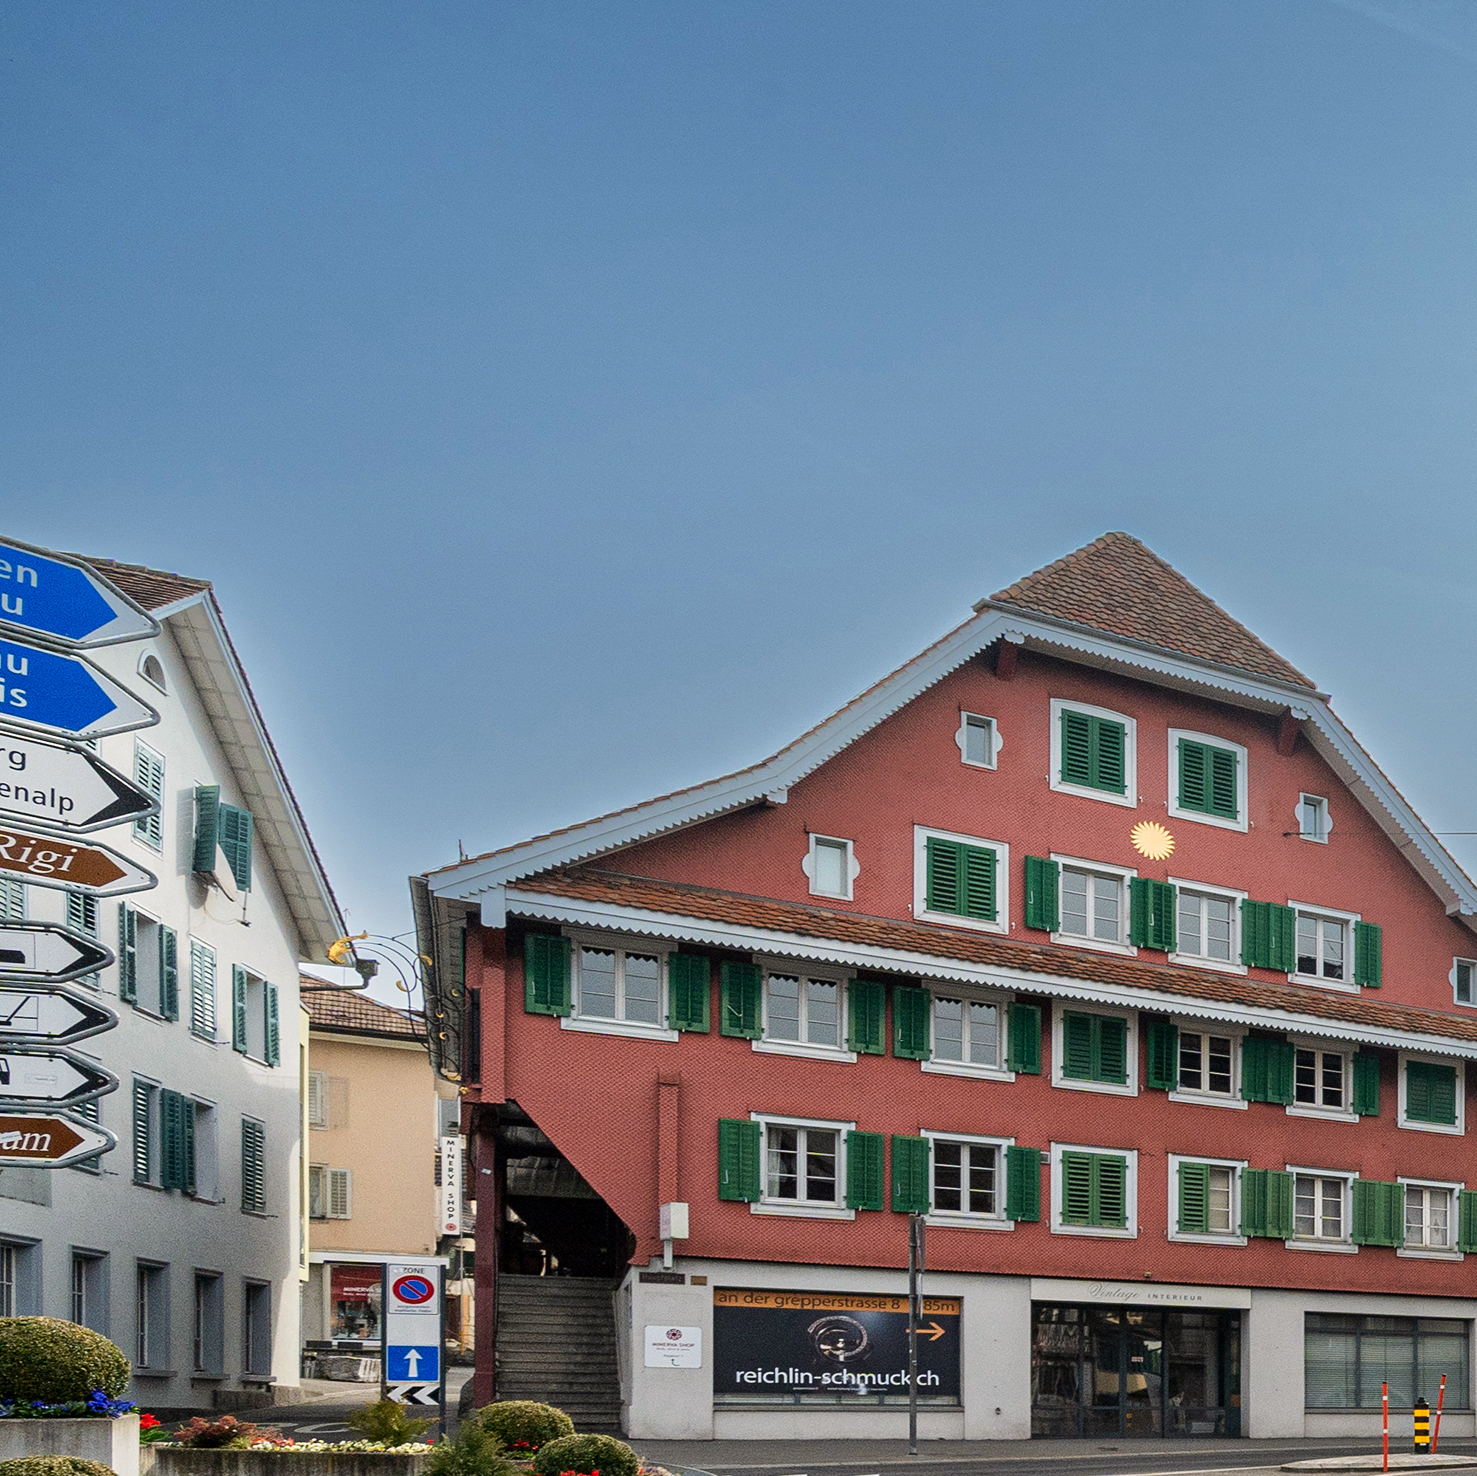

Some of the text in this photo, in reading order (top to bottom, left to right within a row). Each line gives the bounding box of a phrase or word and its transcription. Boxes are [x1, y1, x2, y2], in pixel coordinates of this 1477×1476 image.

[0, 654, 28, 676] u
[446, 1140, 455, 1219] MINERVA SHOP
[719, 1291, 955, 1312] an der grepperstrasse 8 85m
[1088, 1283, 1202, 1302] Vintage INTERIEUR
[735, 1368, 940, 1387] reichlin-schmuckch
